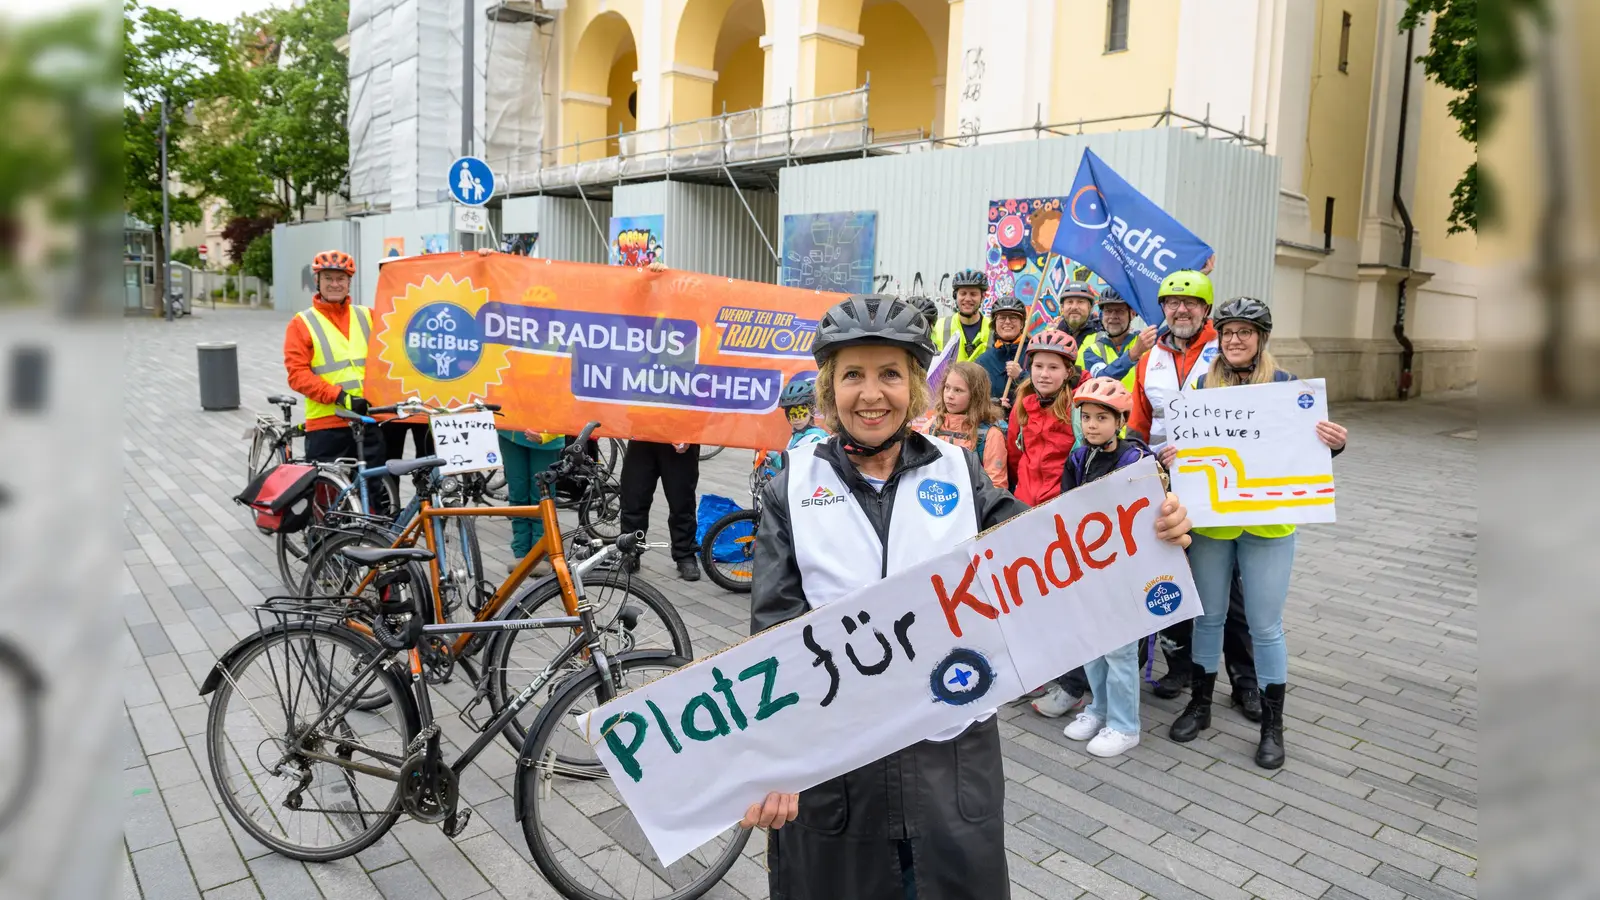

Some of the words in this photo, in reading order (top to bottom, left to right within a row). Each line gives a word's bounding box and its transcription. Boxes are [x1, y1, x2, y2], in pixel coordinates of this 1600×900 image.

[1101, 239, 1124, 265] Fahrra
[1111, 216, 1177, 272] adfc
[720, 307, 755, 323] WERDE
[755, 311, 774, 325] TEIL
[773, 313, 794, 327] DER
[408, 332, 479, 352] BiciBus
[484, 311, 540, 343] DER
[548, 320, 686, 356] RADLBUS
[583, 364, 612, 390] IN
[622, 363, 772, 401] MÜNCHEN
[1169, 398, 1256, 420] Sicherer
[801, 495, 846, 508] SIGMA
[919, 490, 958, 502] BiciBus
[1143, 574, 1175, 593] MÜNCHEN
[1147, 590, 1181, 609] BiciBus
[599, 656, 800, 783] Platz
[803, 610, 916, 708] für
[930, 497, 1150, 638] Kinder
[508, 663, 553, 711] TREK
